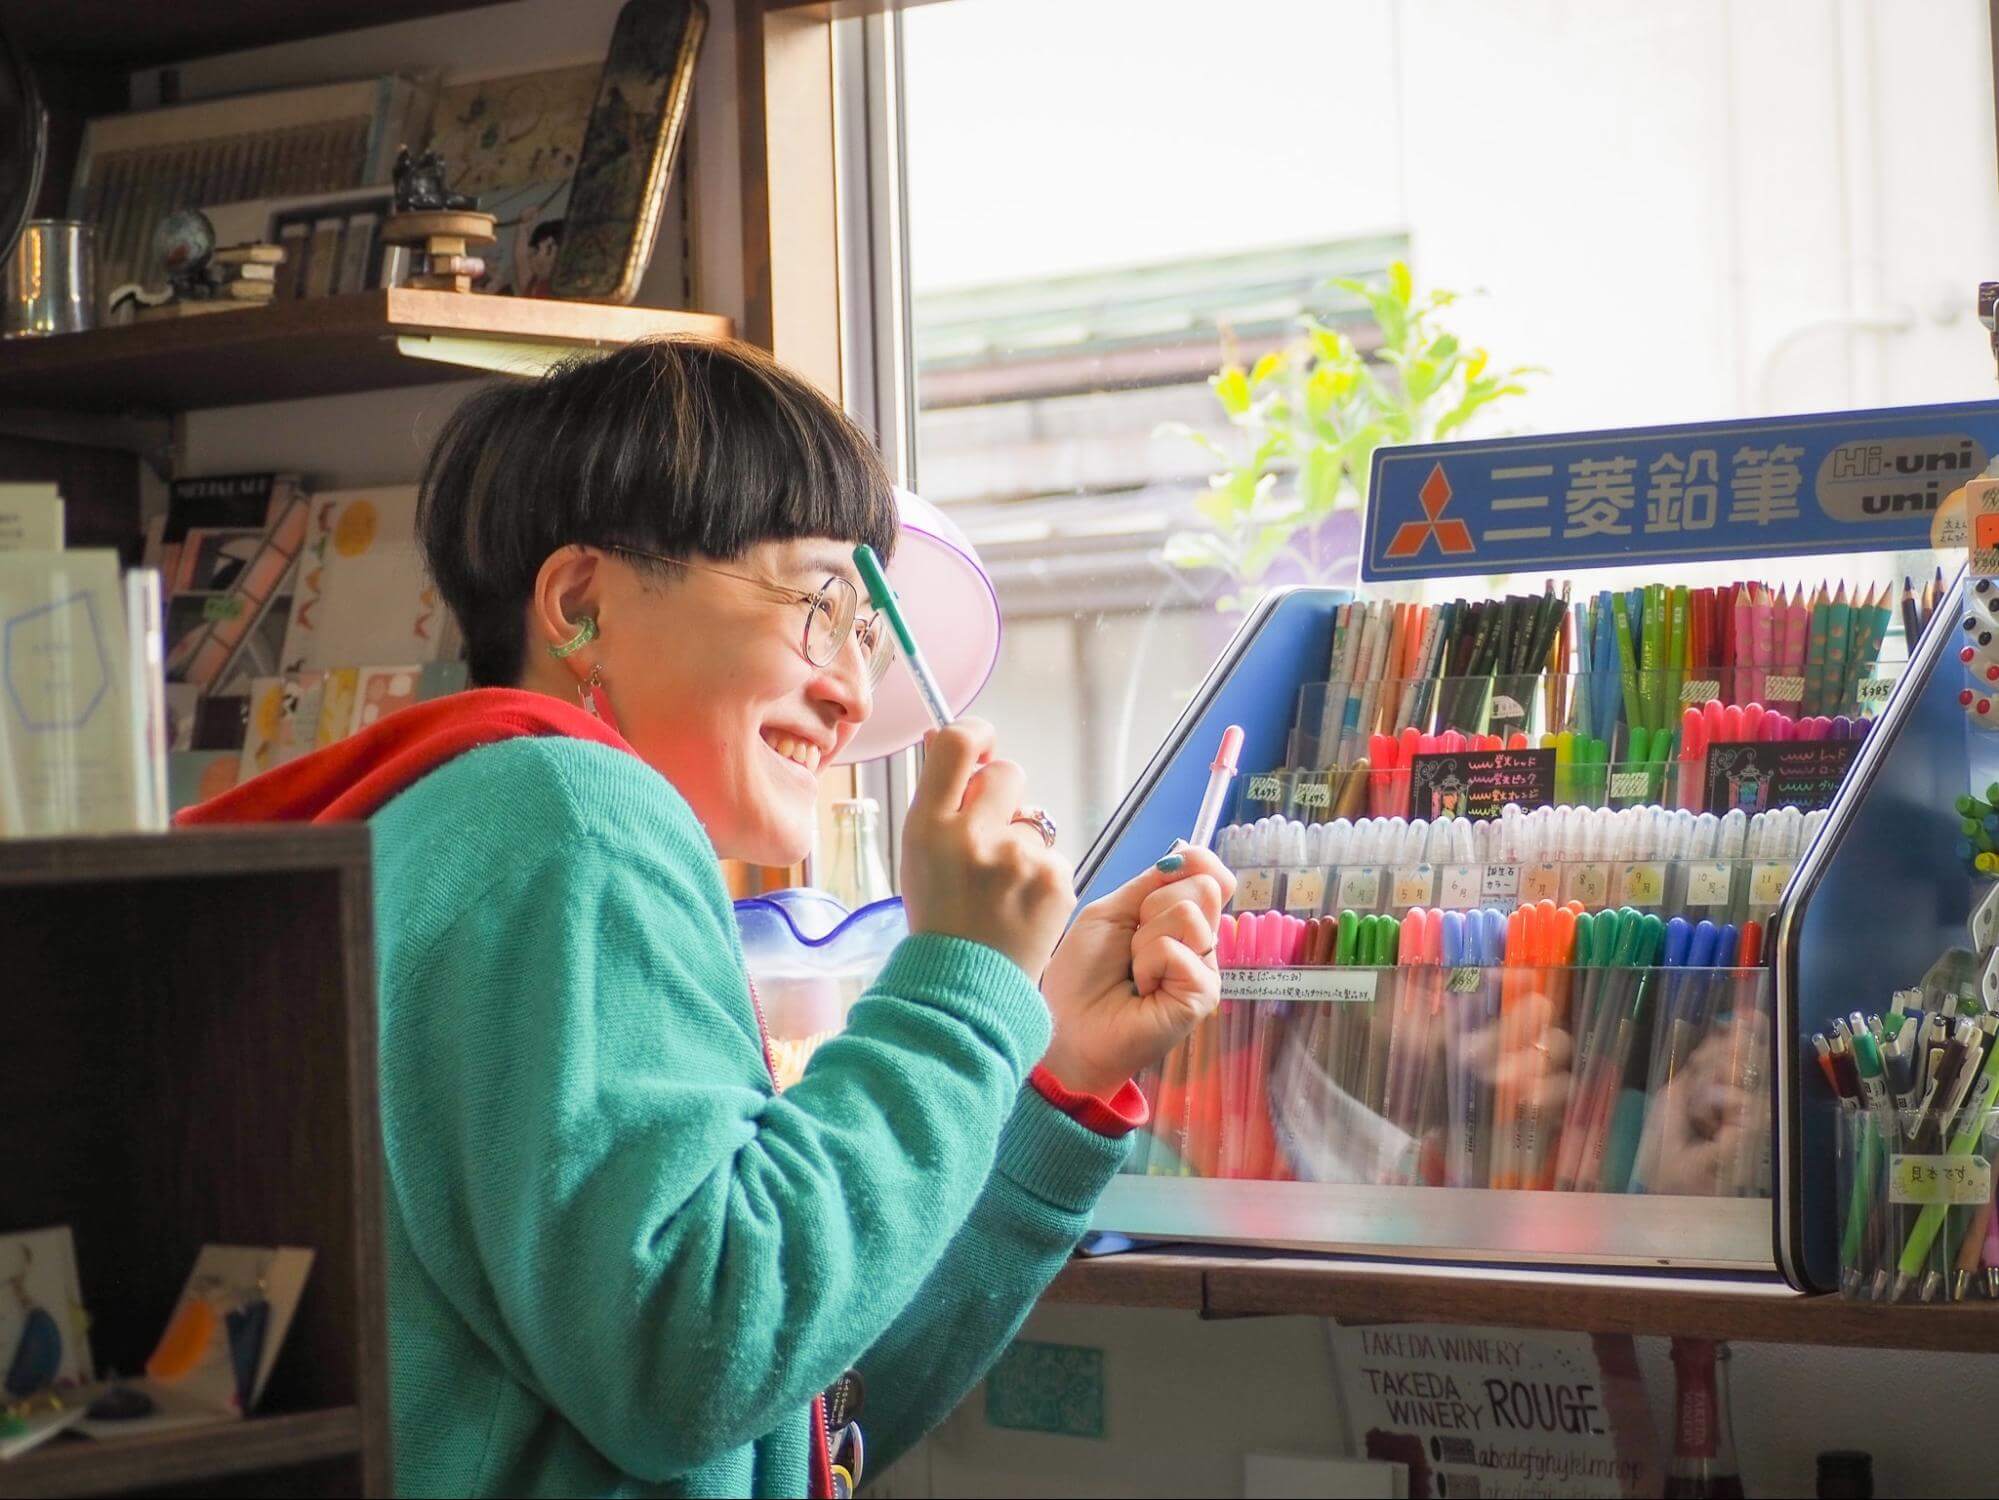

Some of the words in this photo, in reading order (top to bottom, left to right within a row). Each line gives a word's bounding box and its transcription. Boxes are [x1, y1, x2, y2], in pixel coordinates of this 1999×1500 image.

[1833, 440, 1973, 479] Hi-uni
[1484, 442, 1806, 542] 三菱鉛筆
[1862, 481, 1939, 515] uni
[1911, 1165, 1974, 1187] 見本です。
[1360, 1367, 1461, 1401] TAKEDA
[1385, 1399, 1482, 1432] WINERY
[1484, 1378, 1605, 1435] ROUGE
